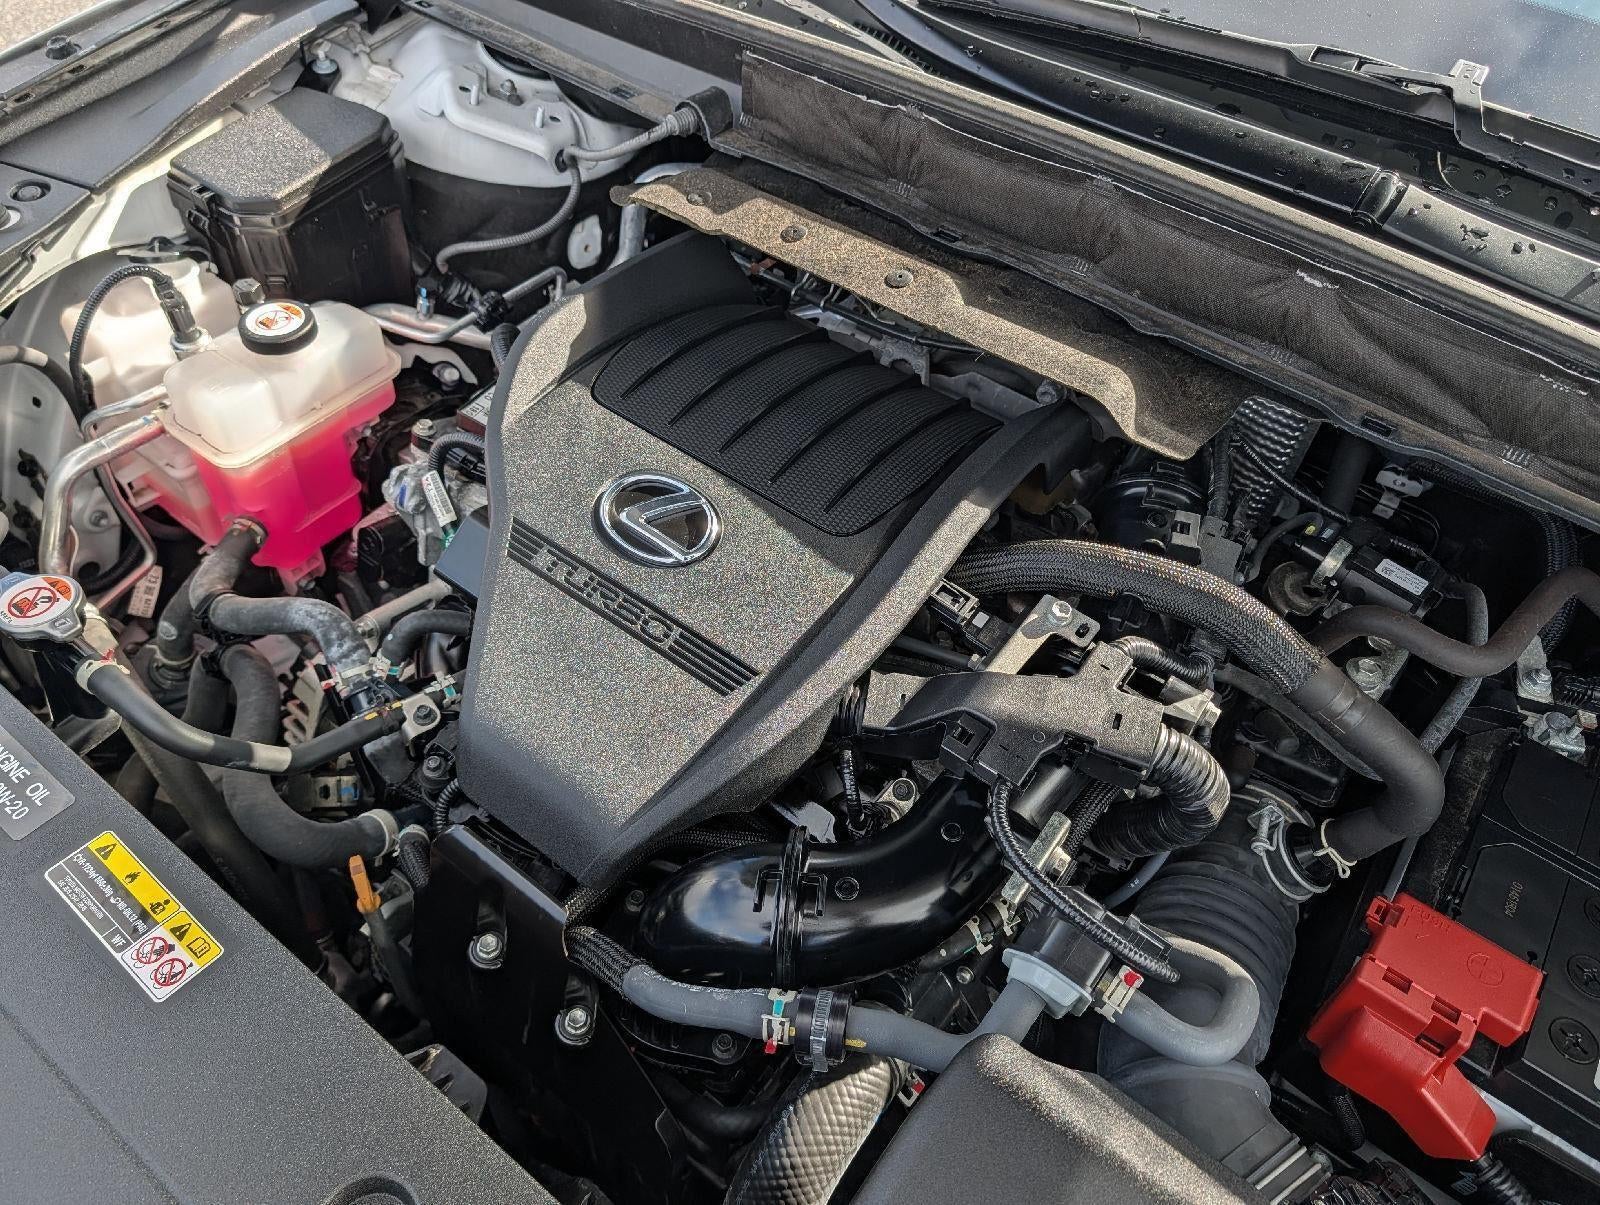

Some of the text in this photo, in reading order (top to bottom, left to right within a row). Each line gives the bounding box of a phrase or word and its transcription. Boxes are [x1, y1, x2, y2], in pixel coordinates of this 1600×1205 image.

[546, 548, 675, 644] TURBO
[0, 744, 50, 807] NGINE OIL
[111, 934, 126, 948] WF
